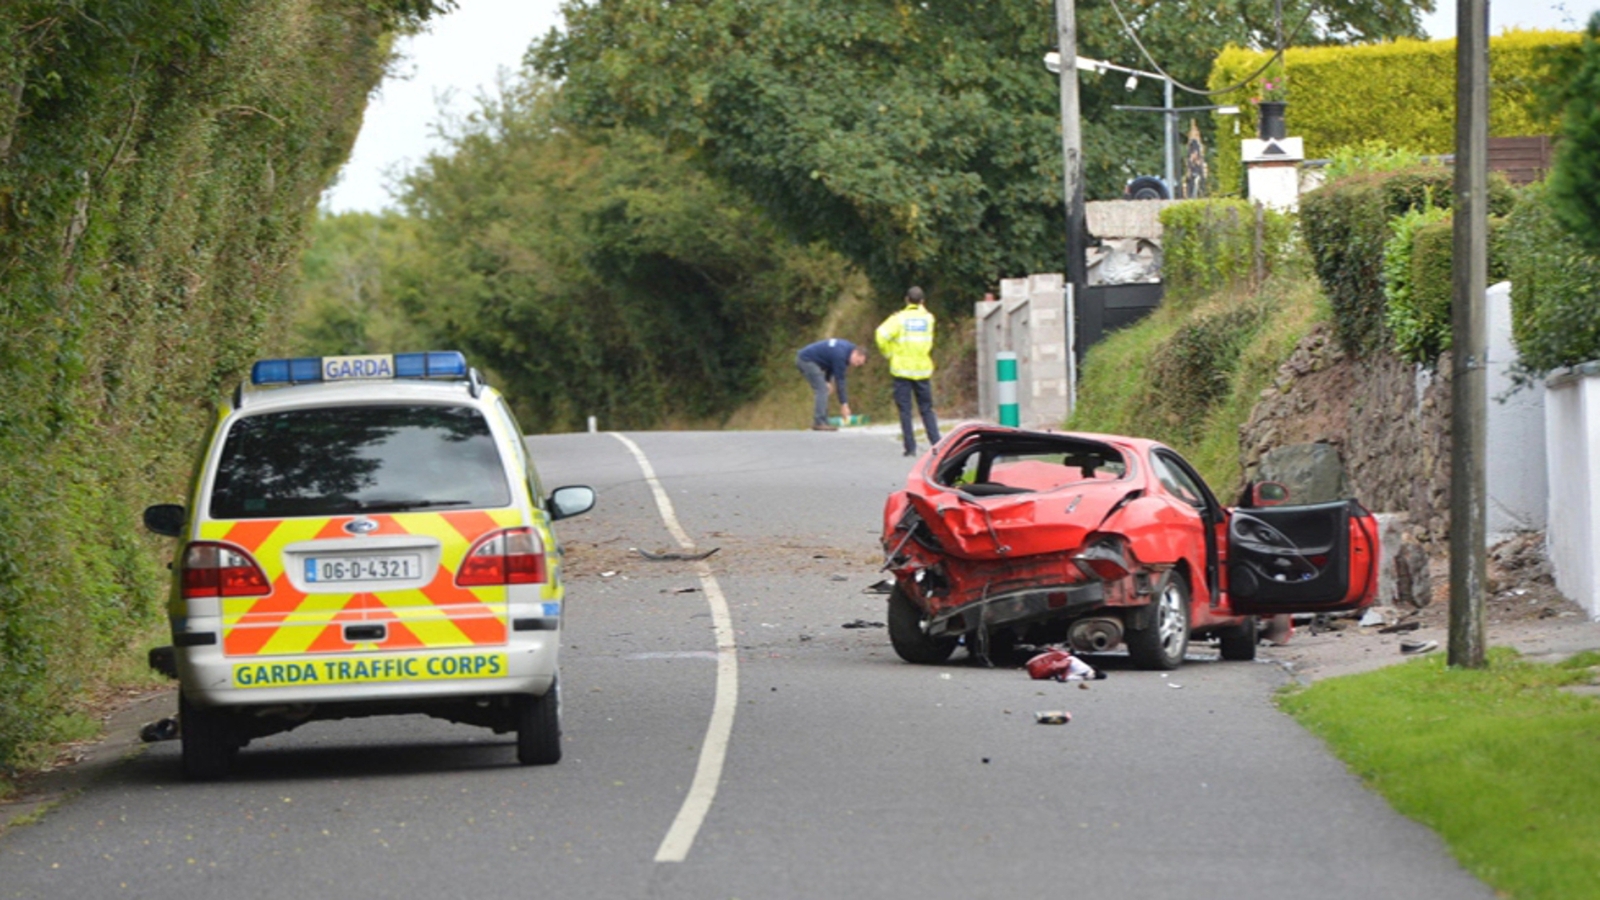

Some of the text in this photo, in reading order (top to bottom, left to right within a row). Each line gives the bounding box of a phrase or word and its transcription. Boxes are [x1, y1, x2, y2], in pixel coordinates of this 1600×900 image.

[326, 359, 391, 378] GARDA
[322, 560, 409, 579] 06-D-4321
[236, 654, 501, 685] GARDA TRAFFIC CORPS
